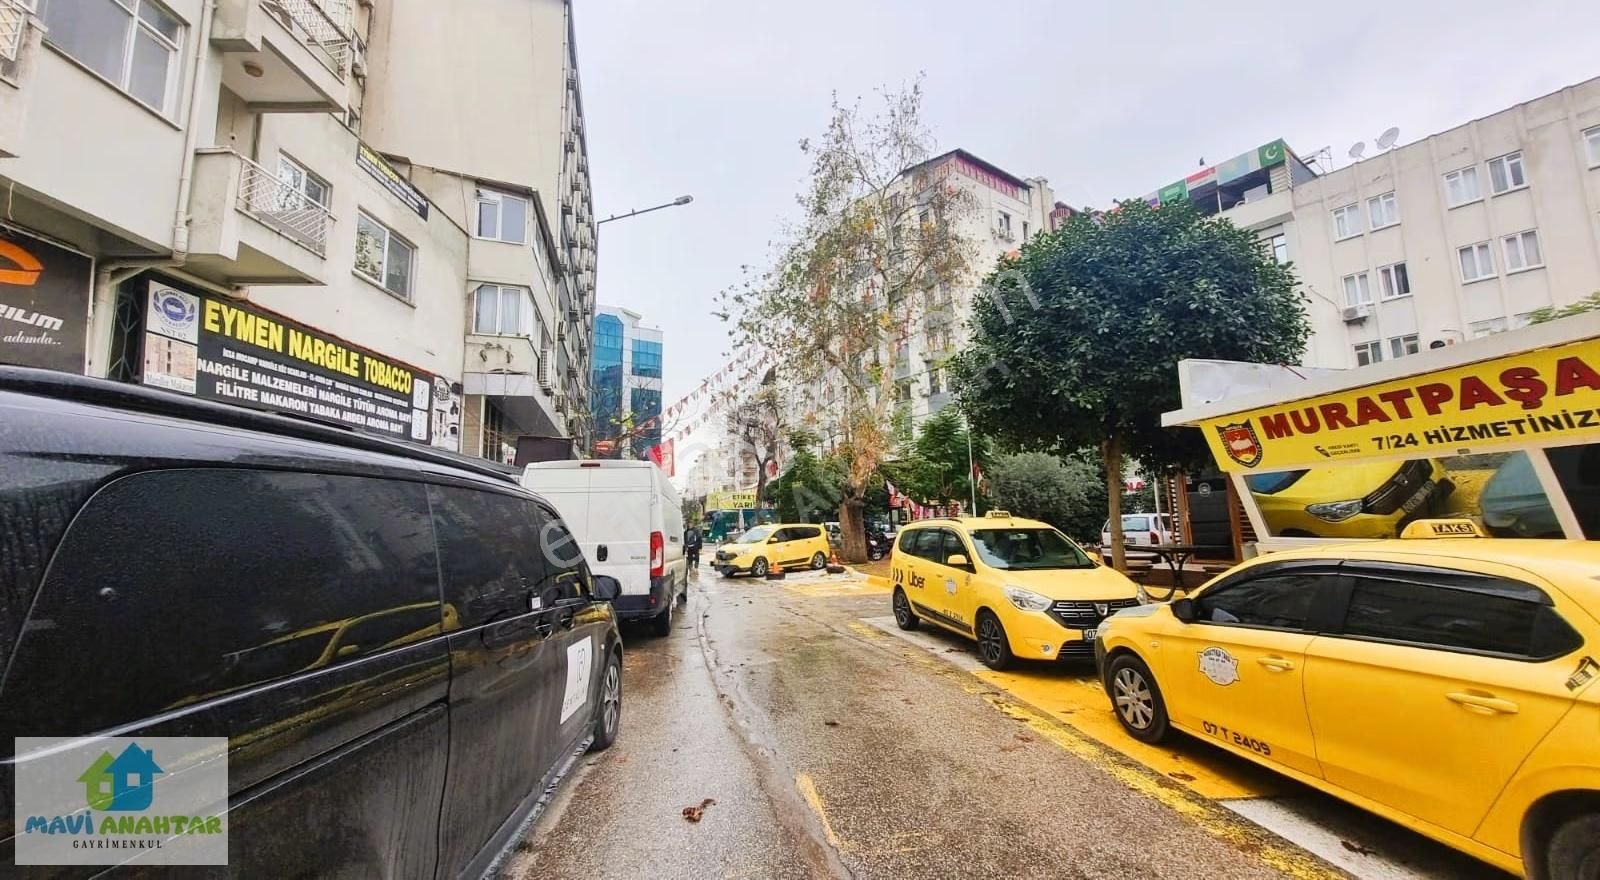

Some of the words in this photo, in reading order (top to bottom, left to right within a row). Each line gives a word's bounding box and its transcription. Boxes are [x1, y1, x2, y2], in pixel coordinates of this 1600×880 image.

[204, 299, 284, 353] EYMEN
[363, 355, 412, 395] TOBACCO
[197, 357, 249, 382] NARGİLE
[251, 371, 317, 398] MALZEMELERİ
[1259, 356, 1600, 440] MURATPAŞA
[215, 380, 259, 402] FİLİTRE
[260, 391, 308, 413] MAKARON
[309, 402, 341, 420] TABAKA
[1371, 432, 1419, 451] 7/24
[1423, 408, 1600, 445] HİZMETİNİZ
[908, 570, 925, 588] Uber
[1202, 720, 1218, 736] 07
[1220, 726, 1229, 740] T
